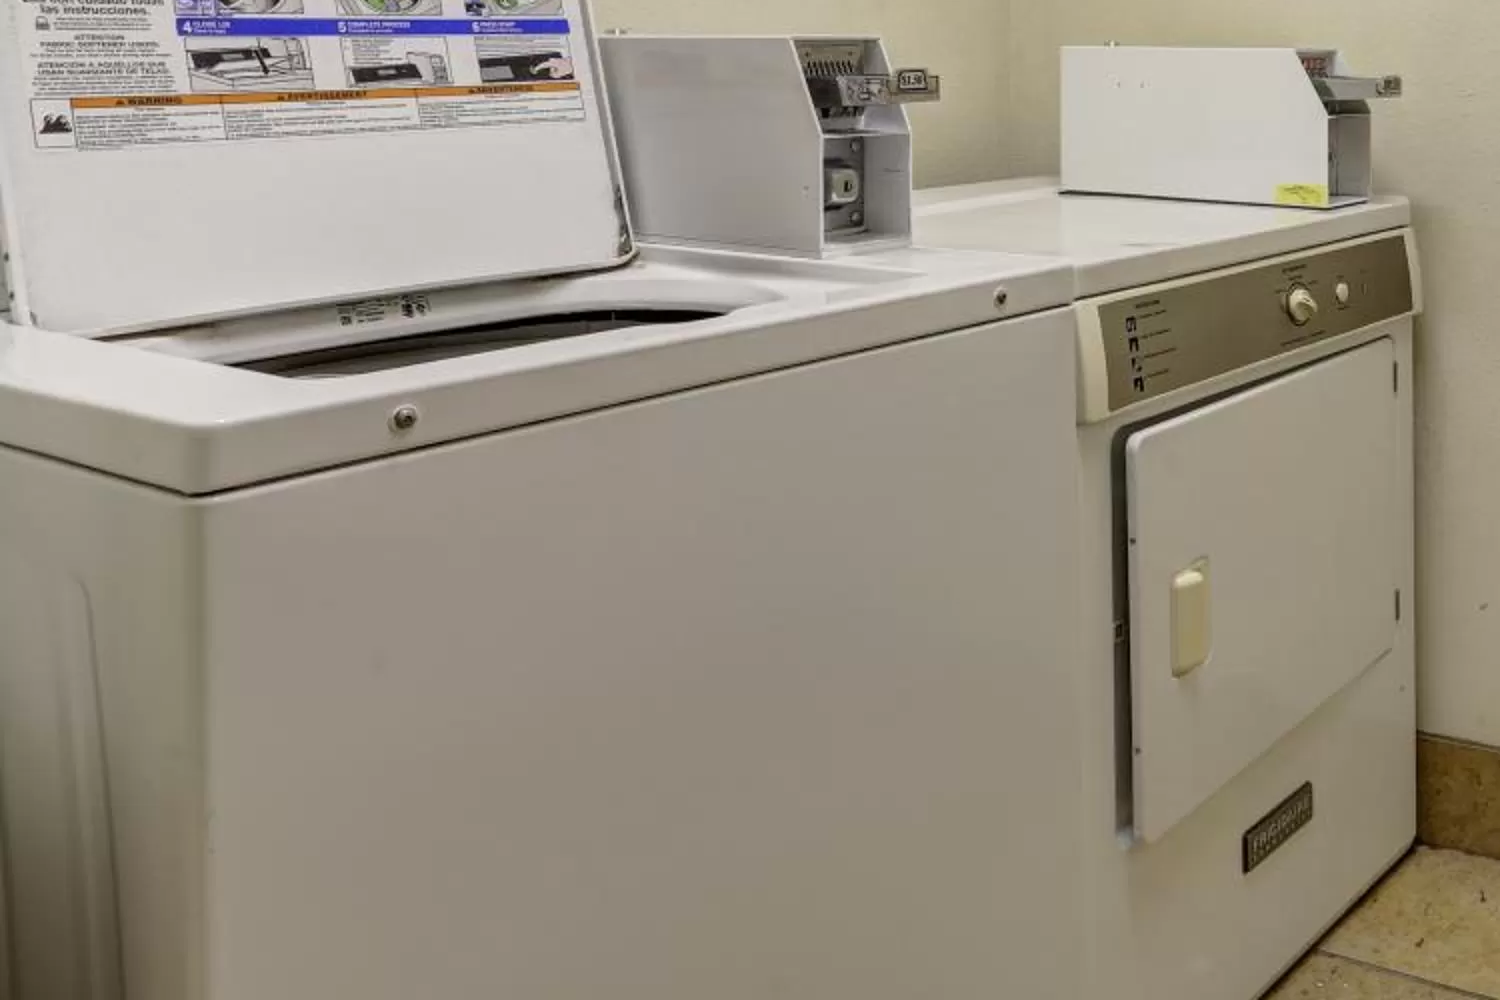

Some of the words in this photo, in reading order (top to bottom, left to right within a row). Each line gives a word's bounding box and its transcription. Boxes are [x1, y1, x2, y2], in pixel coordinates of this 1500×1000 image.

[39, 3, 60, 15] las
[183, 19, 192, 34] 4
[336, 20, 347, 33] 5
[471, 21, 480, 33] 6
[127, 95, 183, 105] WARNING
